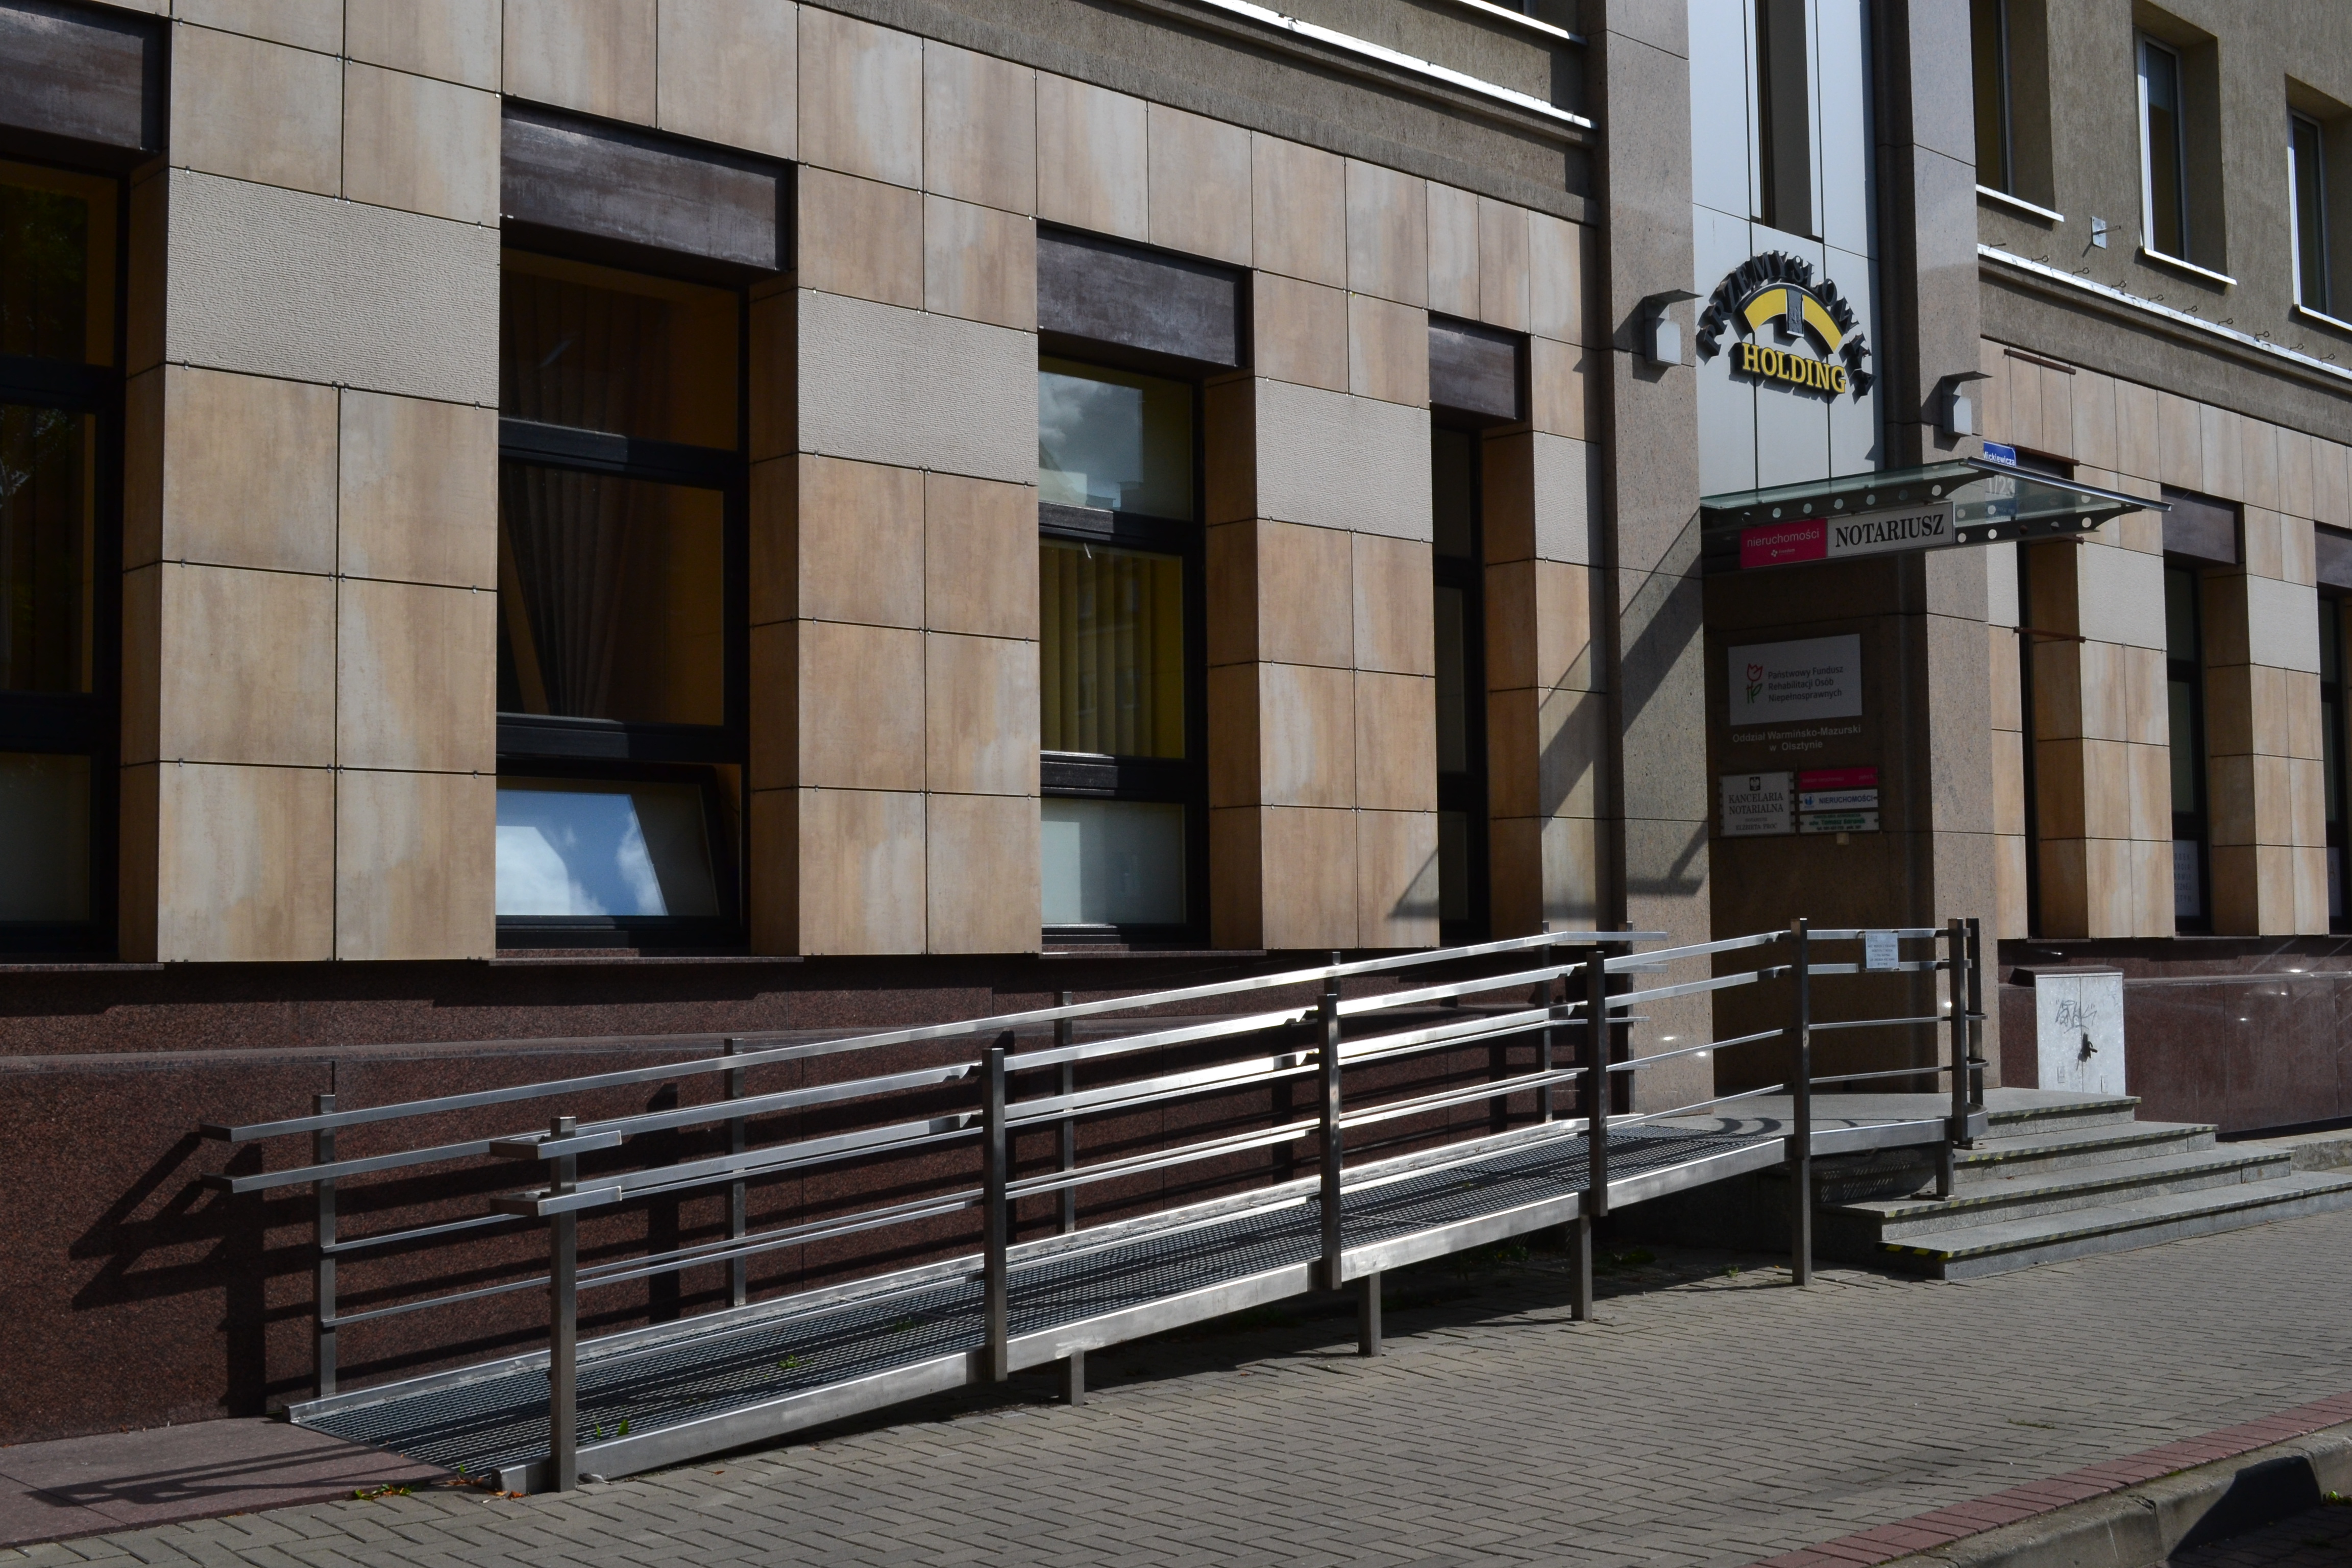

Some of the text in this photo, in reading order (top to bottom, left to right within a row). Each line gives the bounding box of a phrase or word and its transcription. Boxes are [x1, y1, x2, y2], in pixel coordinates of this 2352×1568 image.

[1742, 342, 1846, 394] HOLDING
[1747, 527, 1820, 547] nieruchomości
[1835, 514, 1944, 548] NOTARIUSZ
[1768, 666, 1843, 679] Państwowy Fundusz
[1769, 678, 1834, 690] Rehabilitacji Osób
[1769, 689, 1842, 702] Niepełnosprawnych
[1732, 724, 1861, 743] Oddział Warmińsko-Mazurski
[1781, 740, 1823, 751] Olsztynie
[1728, 792, 1783, 803] KANCELARIA
[1819, 794, 1873, 804] NIERUCHOMOŚCI
[1729, 803, 1783, 815] NOTARIALNA
